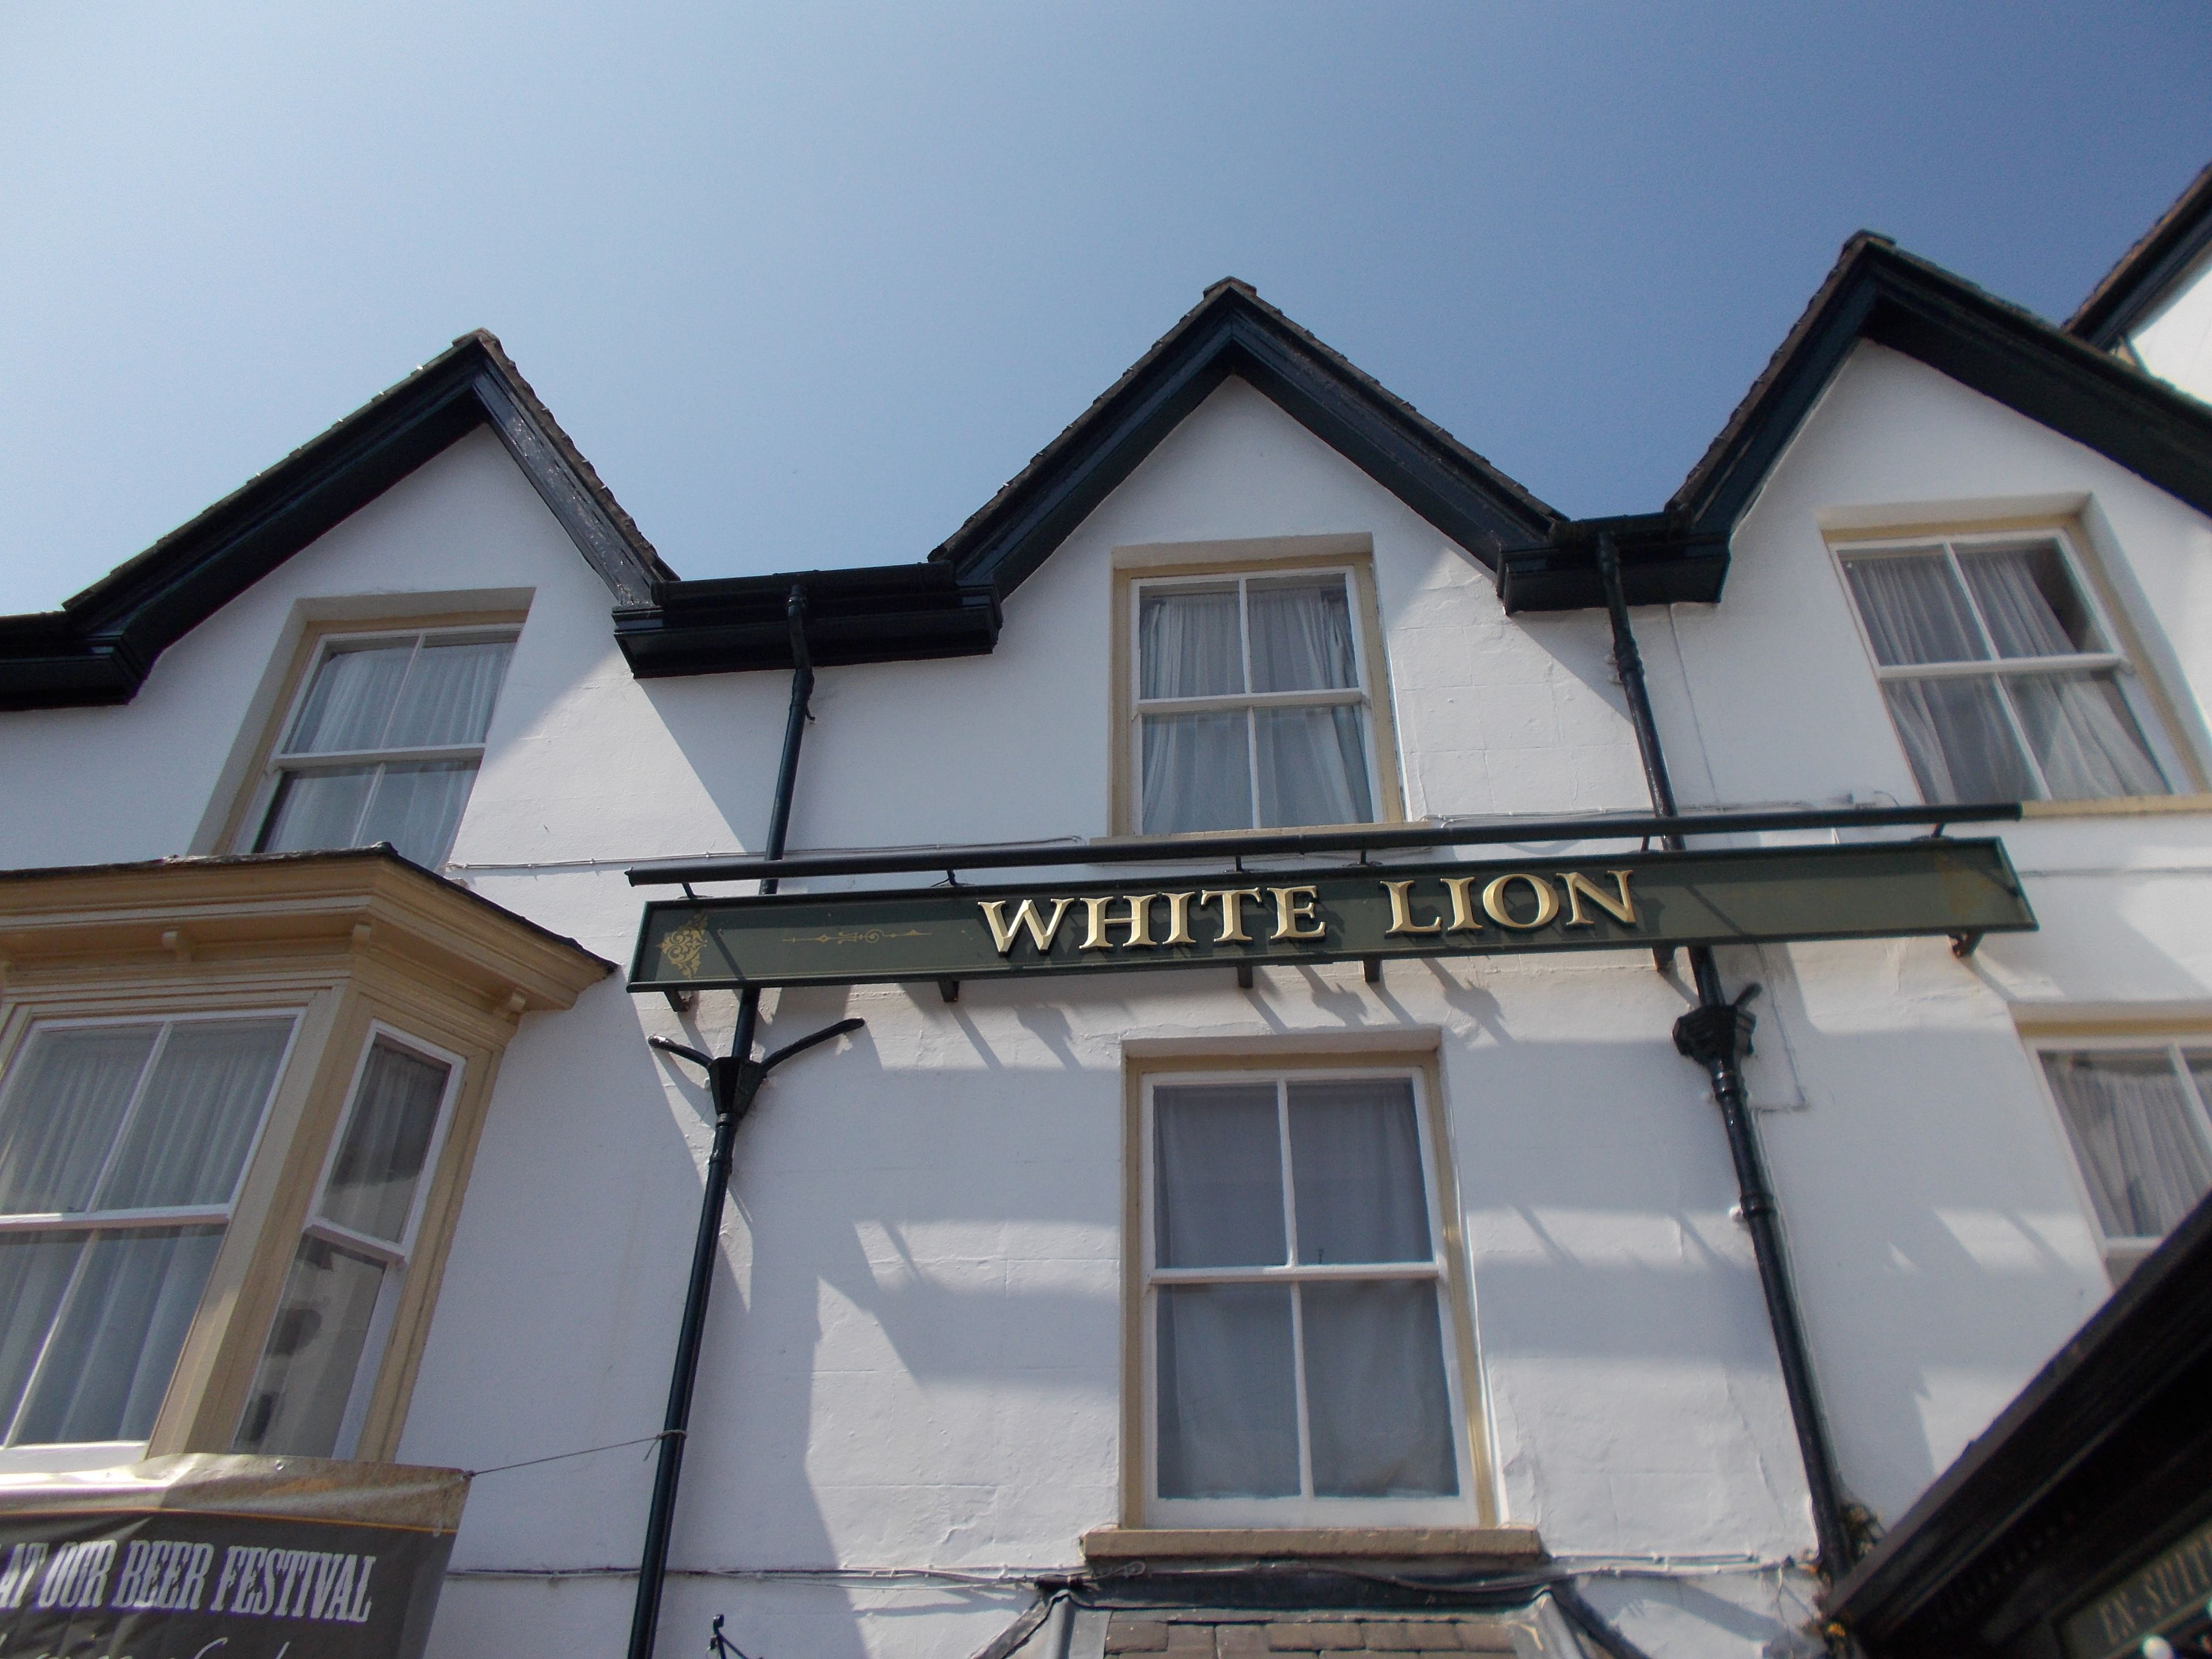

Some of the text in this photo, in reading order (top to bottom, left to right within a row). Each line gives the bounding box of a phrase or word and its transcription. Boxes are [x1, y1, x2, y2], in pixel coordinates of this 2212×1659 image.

[978, 869, 1634, 953] WHITE LION
[0, 1539, 377, 1622] AT OUR BEER FESTIVAL
